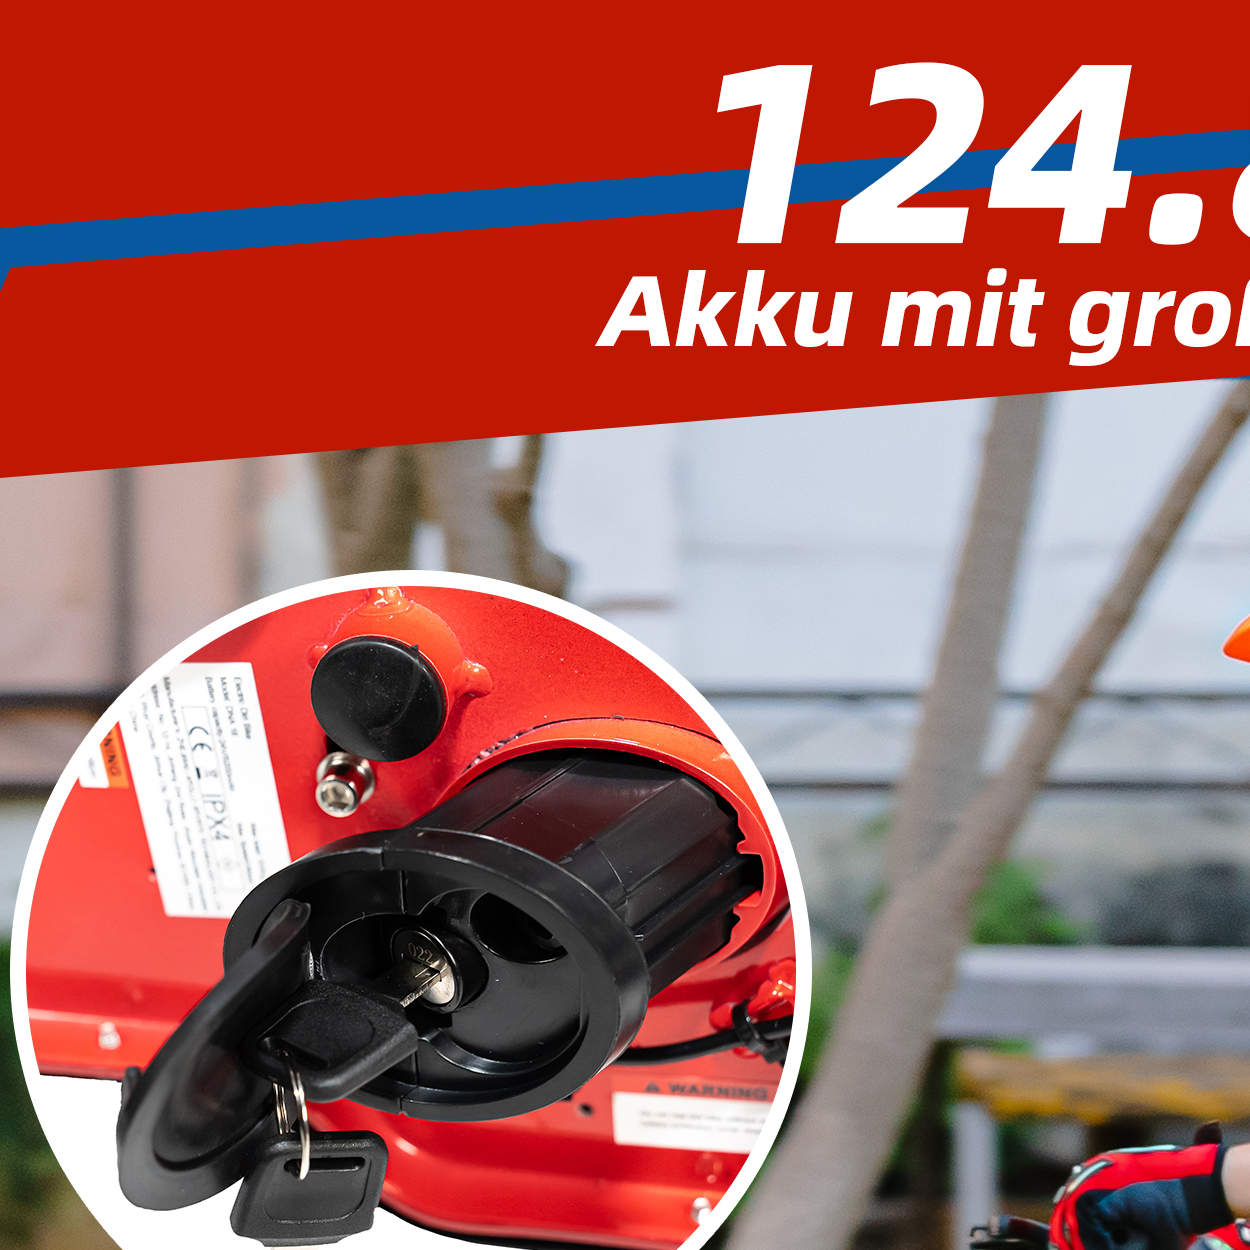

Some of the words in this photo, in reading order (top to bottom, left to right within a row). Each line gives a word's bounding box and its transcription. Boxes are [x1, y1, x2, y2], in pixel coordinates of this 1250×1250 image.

[104, 731, 122, 777] NING
[201, 793, 233, 840] IPX4
[408, 942, 434, 965] 022
